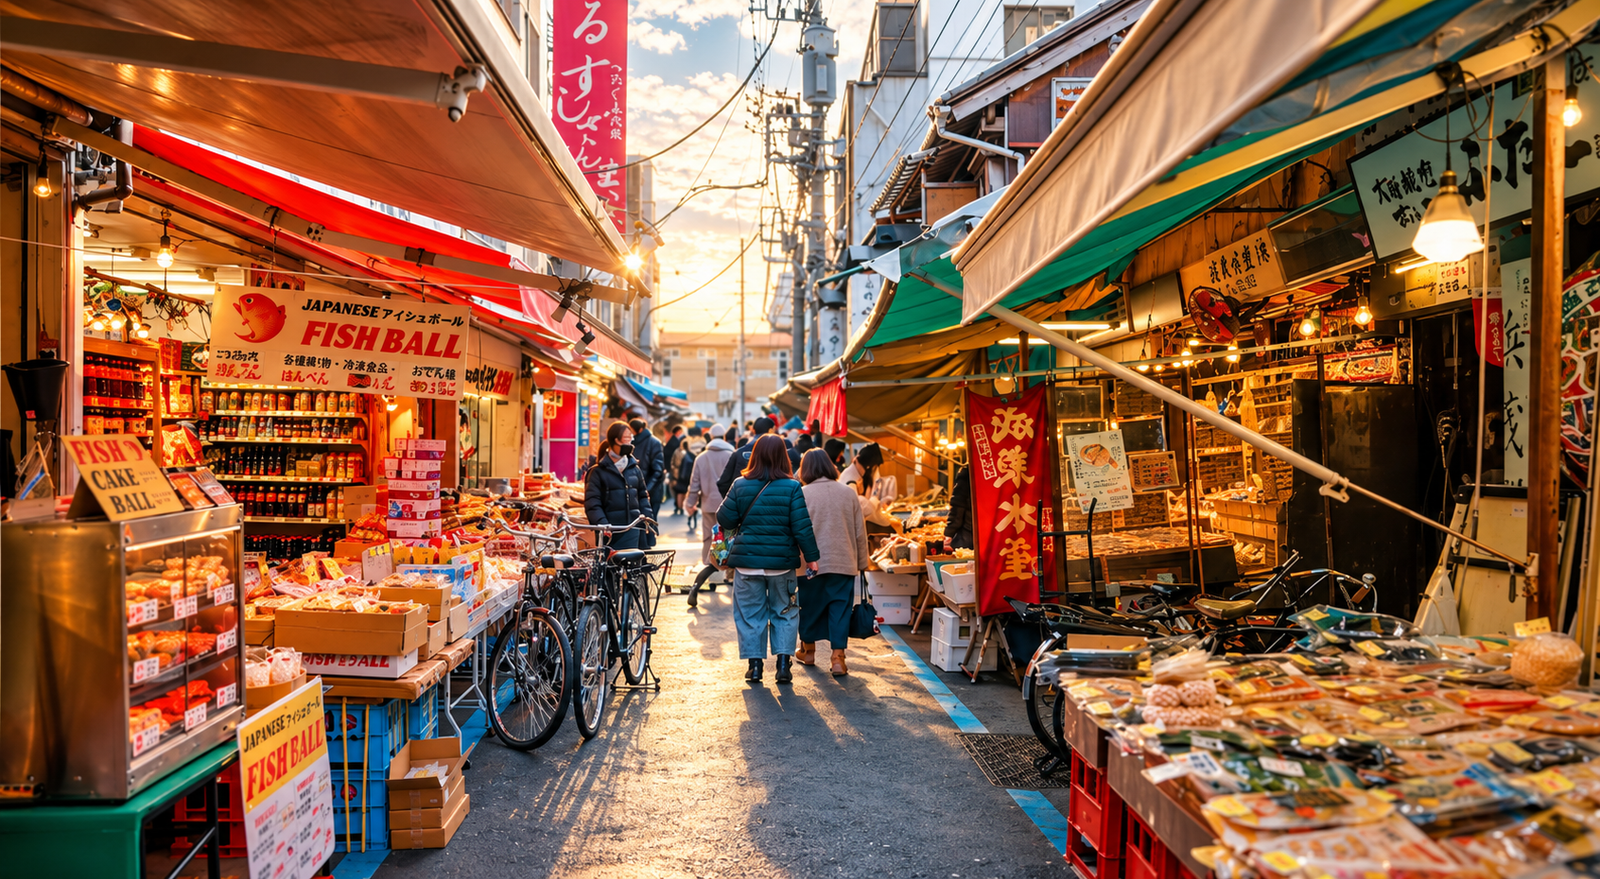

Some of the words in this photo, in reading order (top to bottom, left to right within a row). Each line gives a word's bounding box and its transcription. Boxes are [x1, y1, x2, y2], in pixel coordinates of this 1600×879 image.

[302, 298, 380, 318] JAPANESE
[382, 307, 464, 327] アイシュボール
[300, 320, 381, 350] FISH
[380, 328, 462, 359] BALL
[70, 439, 127, 465] FISH
[91, 468, 140, 491] CAKE
[109, 491, 156, 514] BALL
[243, 714, 285, 753] JAPANESE
[246, 741, 288, 803] FISH
[290, 718, 324, 770] BALL
